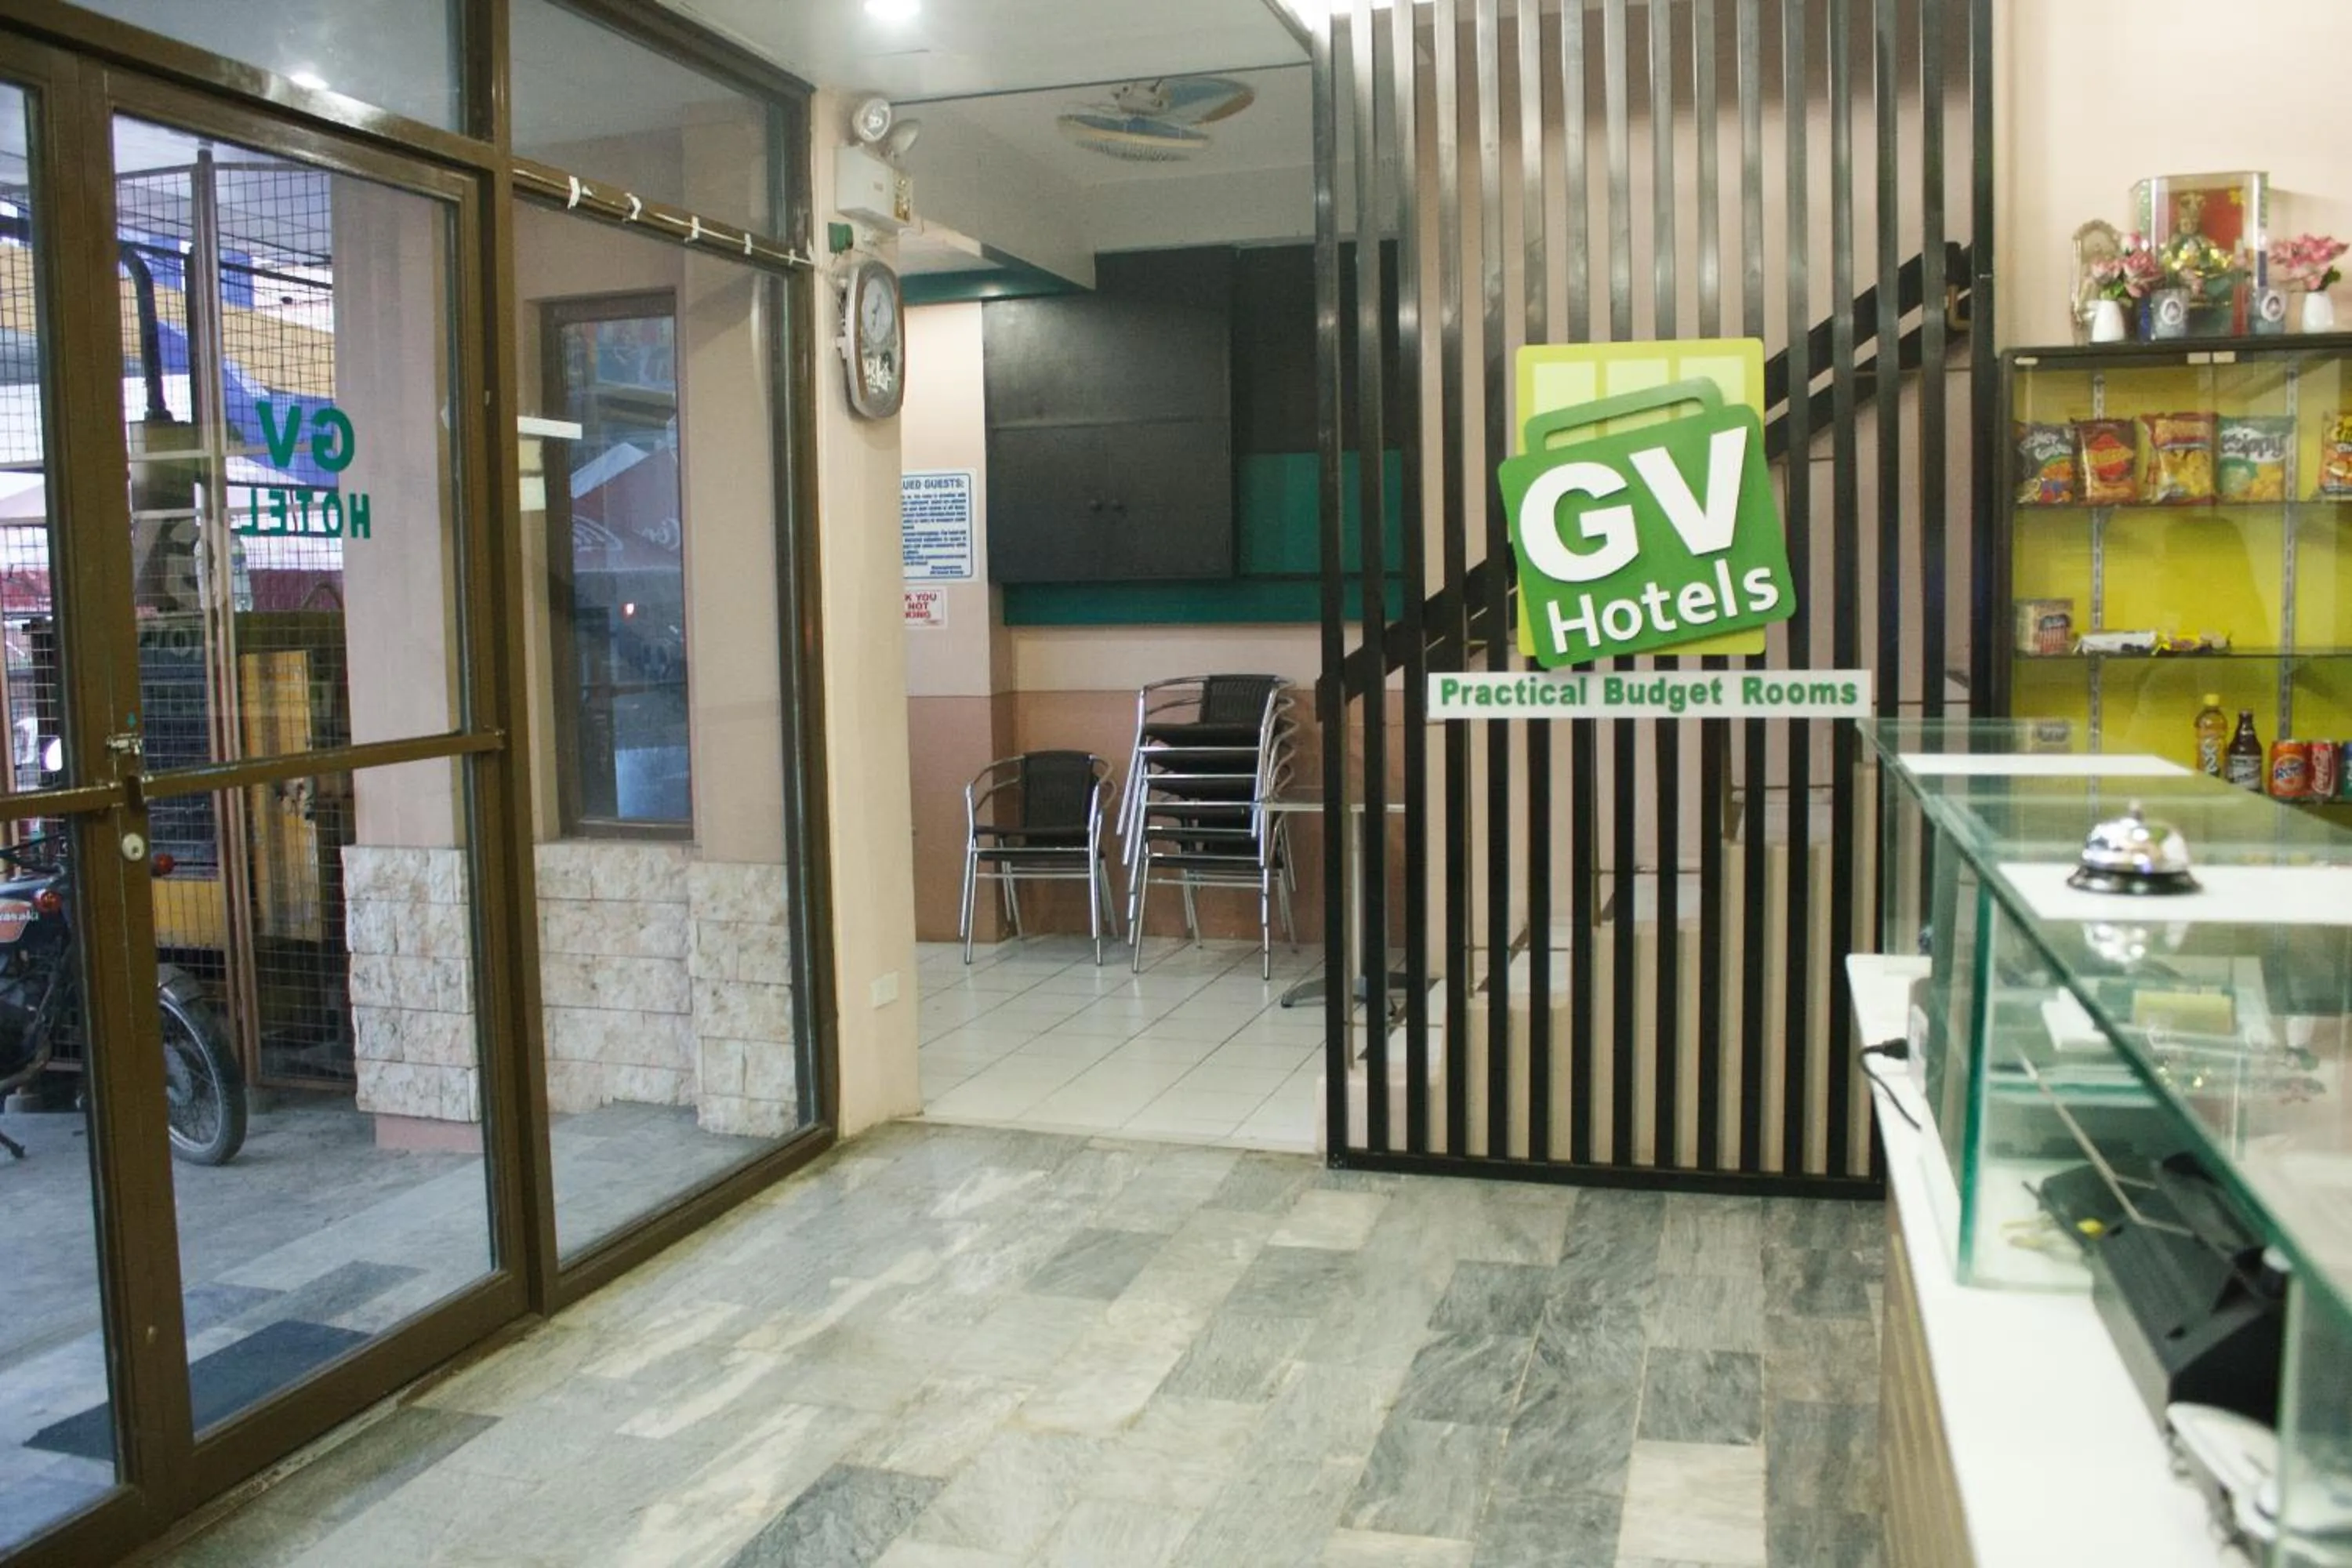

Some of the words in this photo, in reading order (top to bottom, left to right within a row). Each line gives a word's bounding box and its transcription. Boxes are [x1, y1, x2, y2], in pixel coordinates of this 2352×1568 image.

[902, 479, 921, 490] UED
[1519, 426, 1748, 583] GV
[1546, 558, 1780, 655] Hotels
[1441, 677, 1587, 706] Practical
[1603, 676, 1723, 713] Budget
[1742, 676, 1858, 706] Rooms
